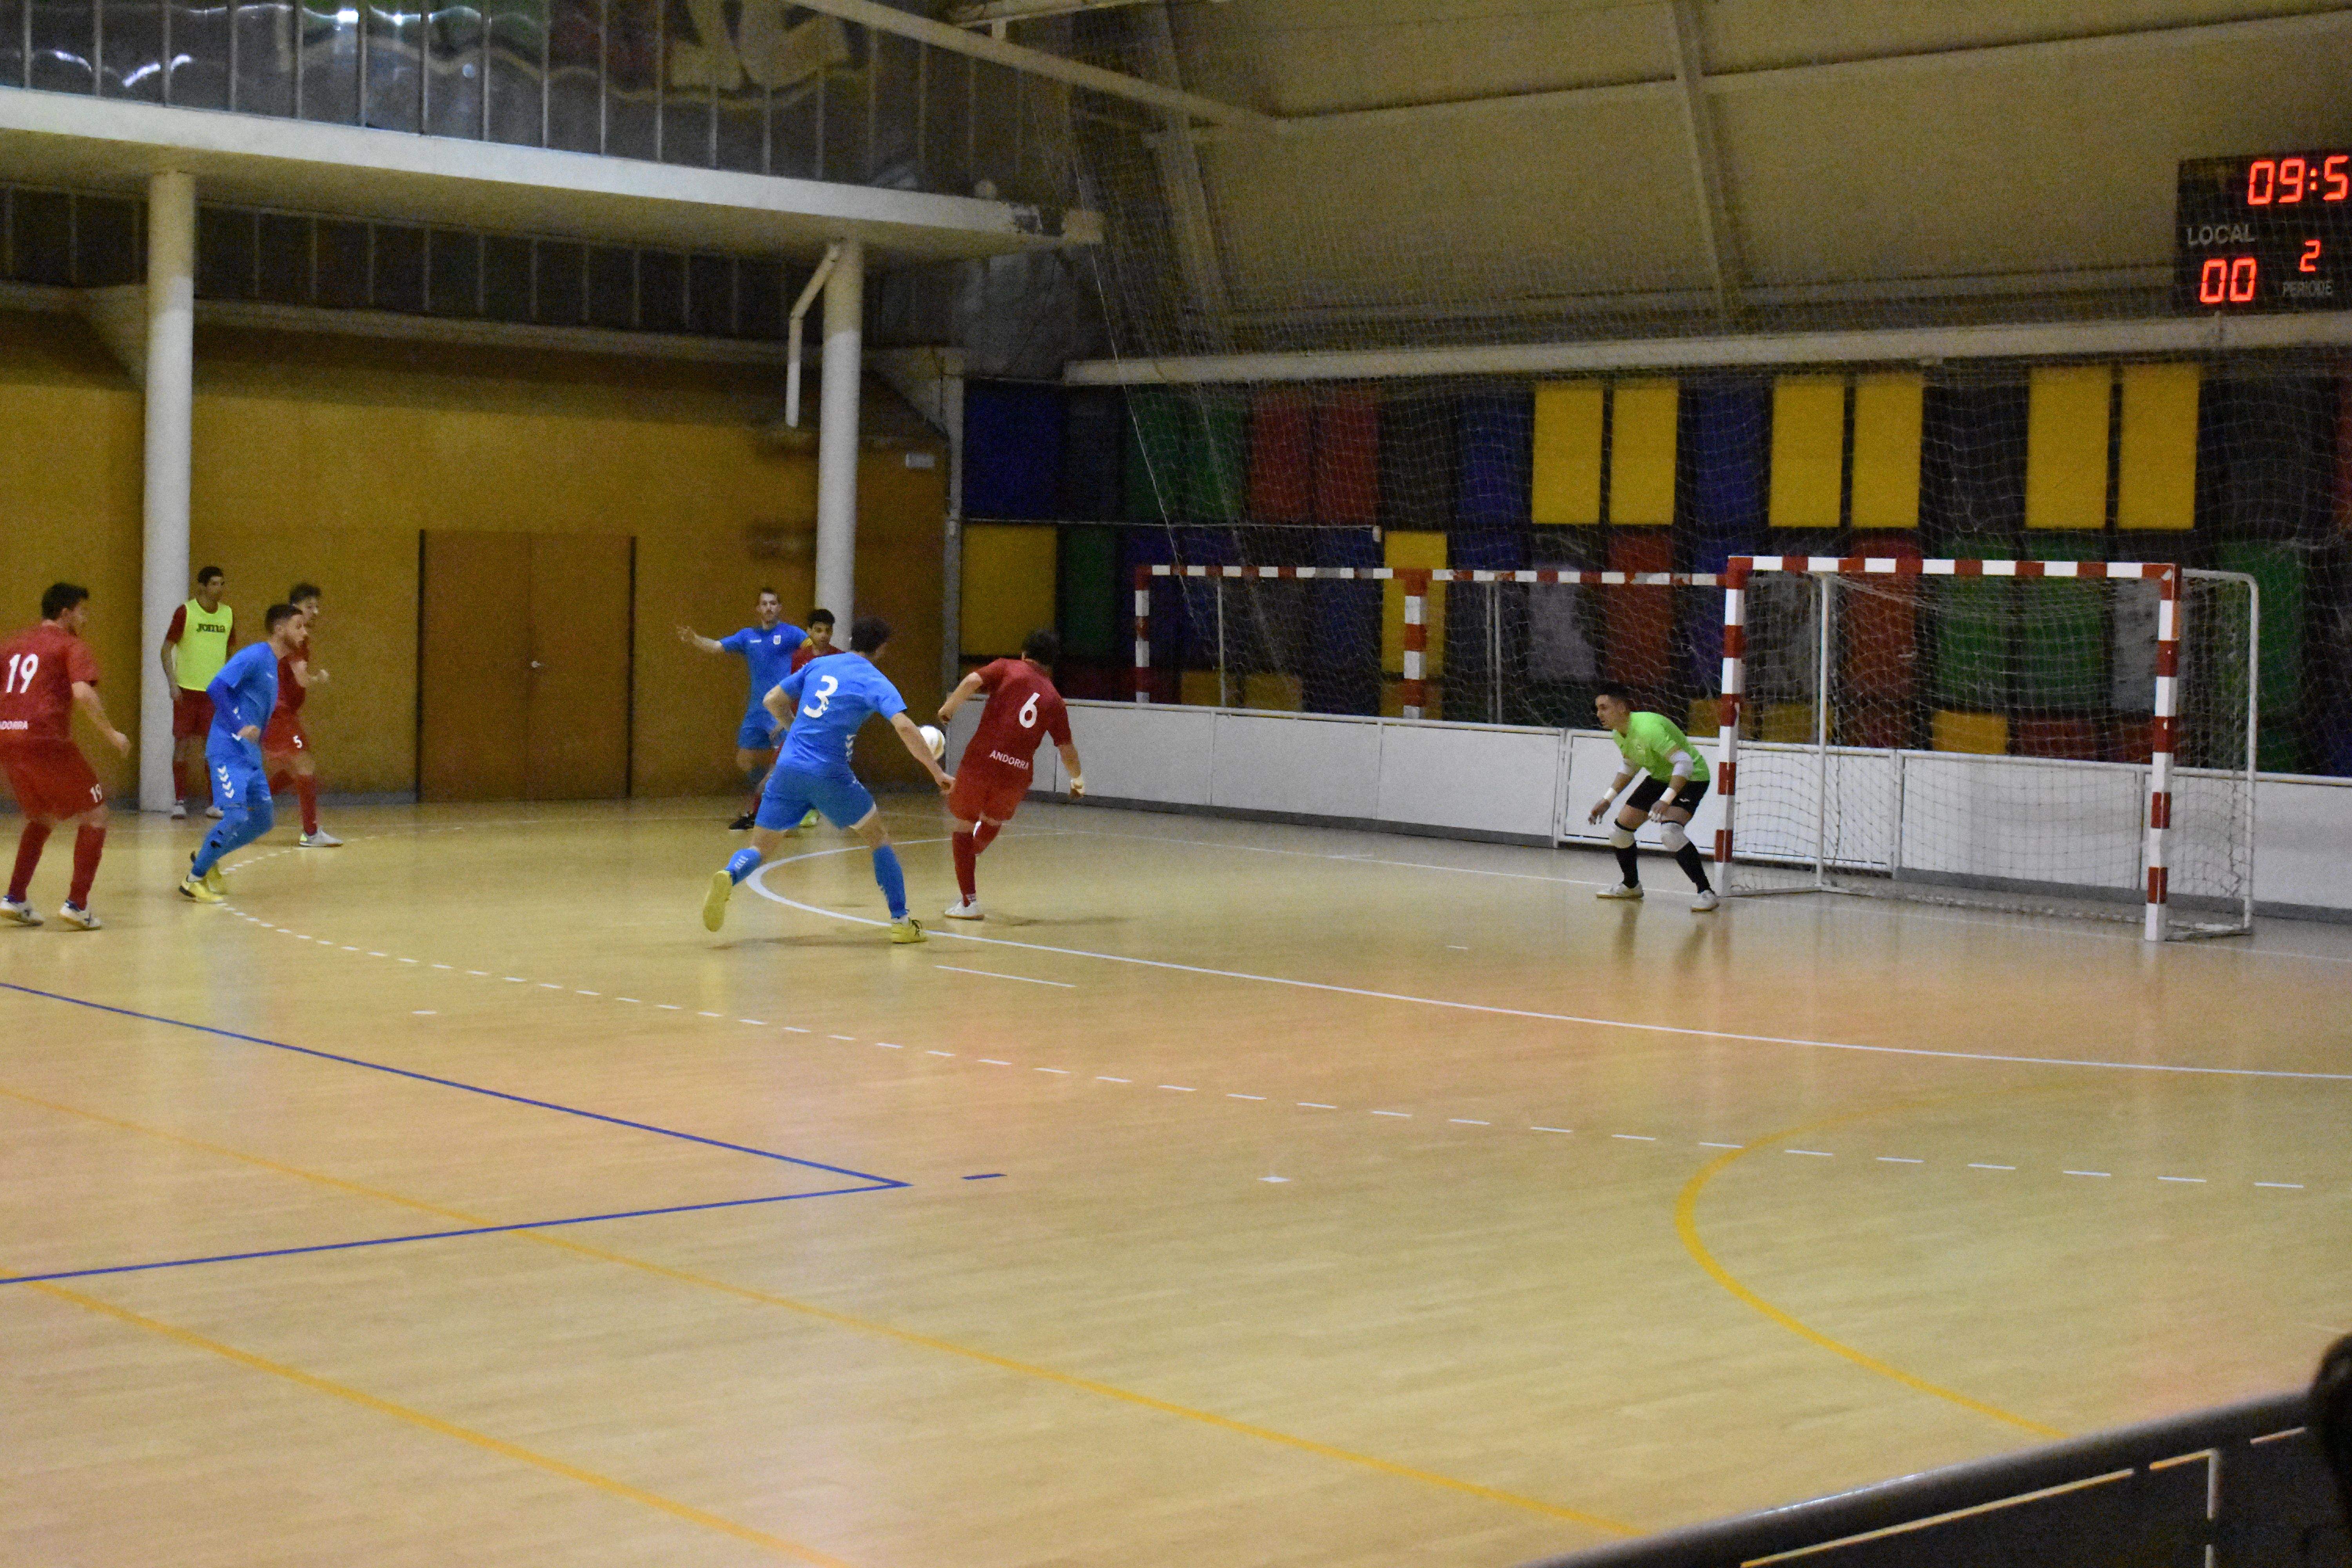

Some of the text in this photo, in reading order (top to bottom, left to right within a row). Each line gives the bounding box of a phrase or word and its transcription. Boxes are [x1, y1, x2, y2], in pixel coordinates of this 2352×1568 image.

[2187, 223, 2255, 247] LOCAL
[2299, 239, 2321, 272] 2
[2200, 257, 2257, 303] 00
[6, 653, 39, 693] 19
[803, 675, 838, 718] 3
[1019, 692, 1040, 728] 6
[293, 735, 303, 748] 5
[989, 750, 1030, 770] ANDORRA
[90, 784, 102, 803] 19
